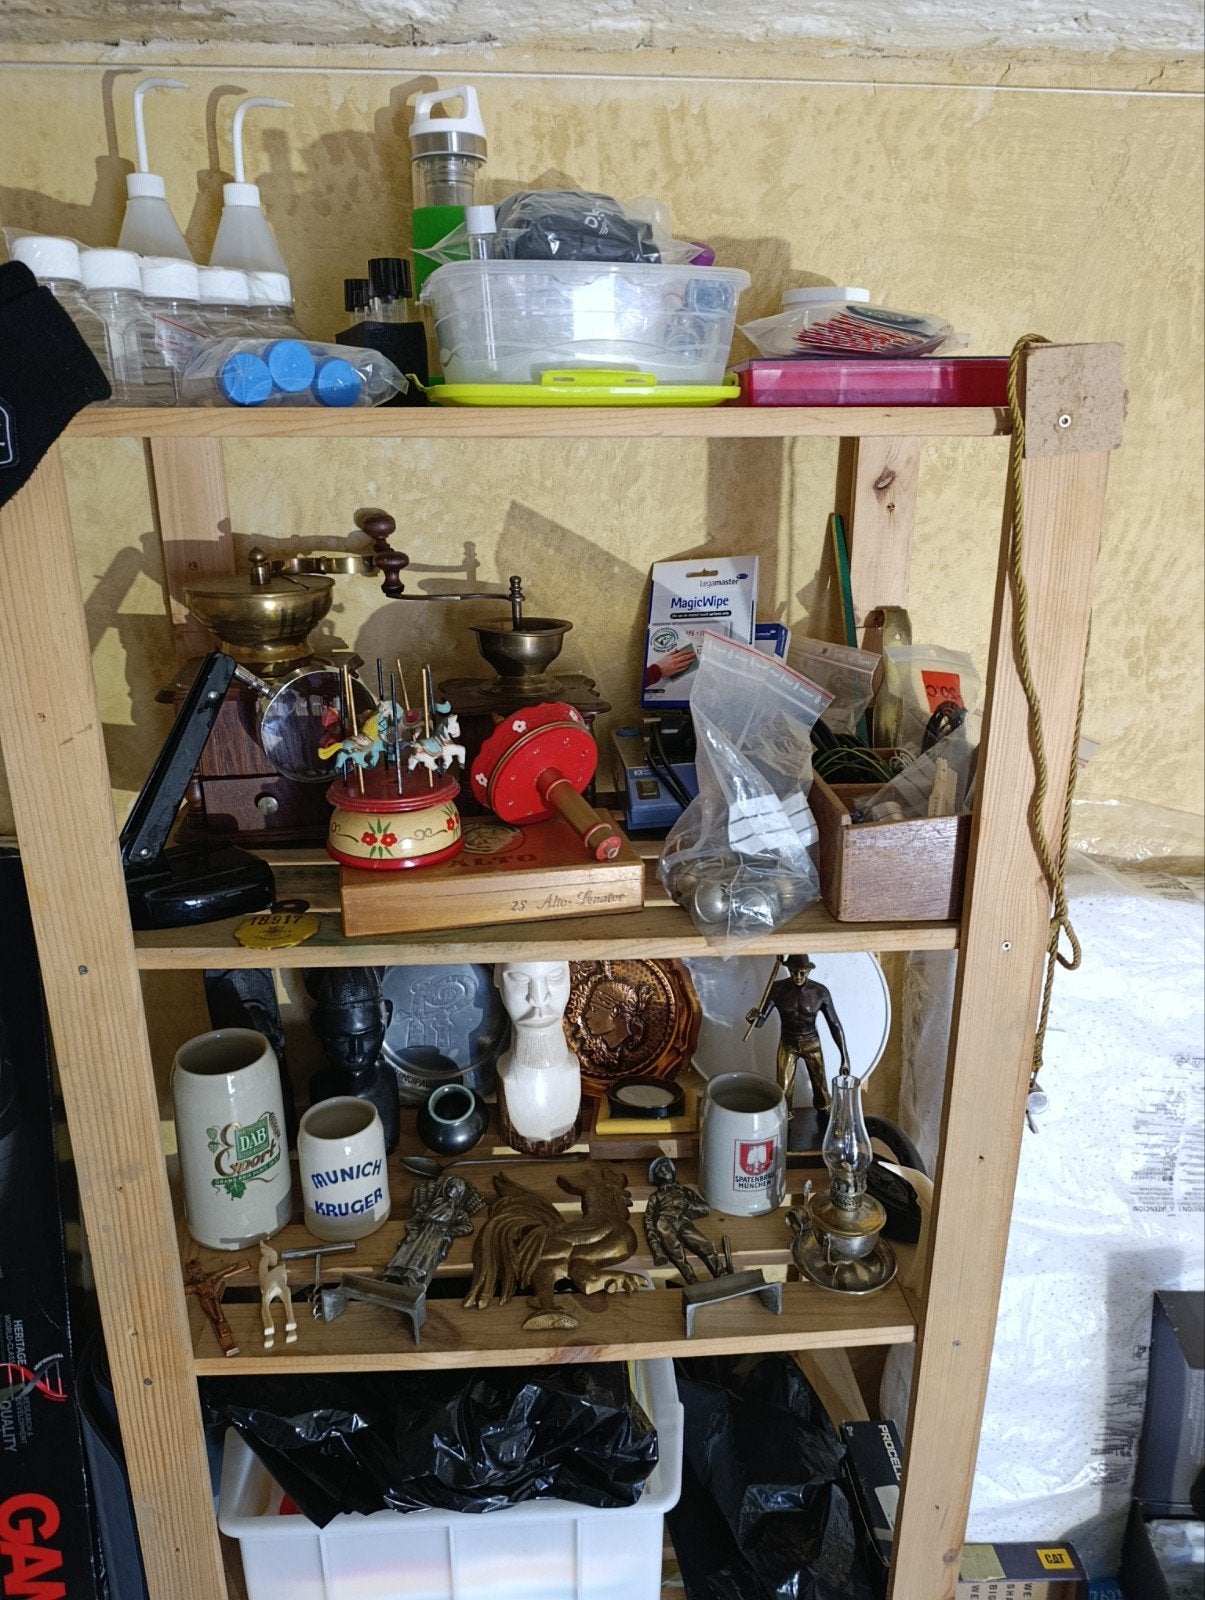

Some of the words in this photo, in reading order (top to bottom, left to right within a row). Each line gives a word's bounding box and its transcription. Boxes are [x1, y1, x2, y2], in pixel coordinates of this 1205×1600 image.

[700, 578, 739, 588] Legamaster
[670, 595, 730, 611] MagicWipe
[449, 853, 538, 868] ALTO
[250, 914, 304, 926] 18917
[214, 1122, 277, 1177] Export
[240, 1127, 267, 1152] DAB
[311, 1158, 382, 1189] MUNICH
[314, 1187, 383, 1217] KRUGER
[4, 1314, 16, 1364] WORLD-CLASS
[13, 1319, 27, 1365] HERITAGE
[0, 1401, 17, 1453] QUALITY
[878, 1424, 902, 1481] PROCELL
[1044, 1553, 1065, 1565] CAT
